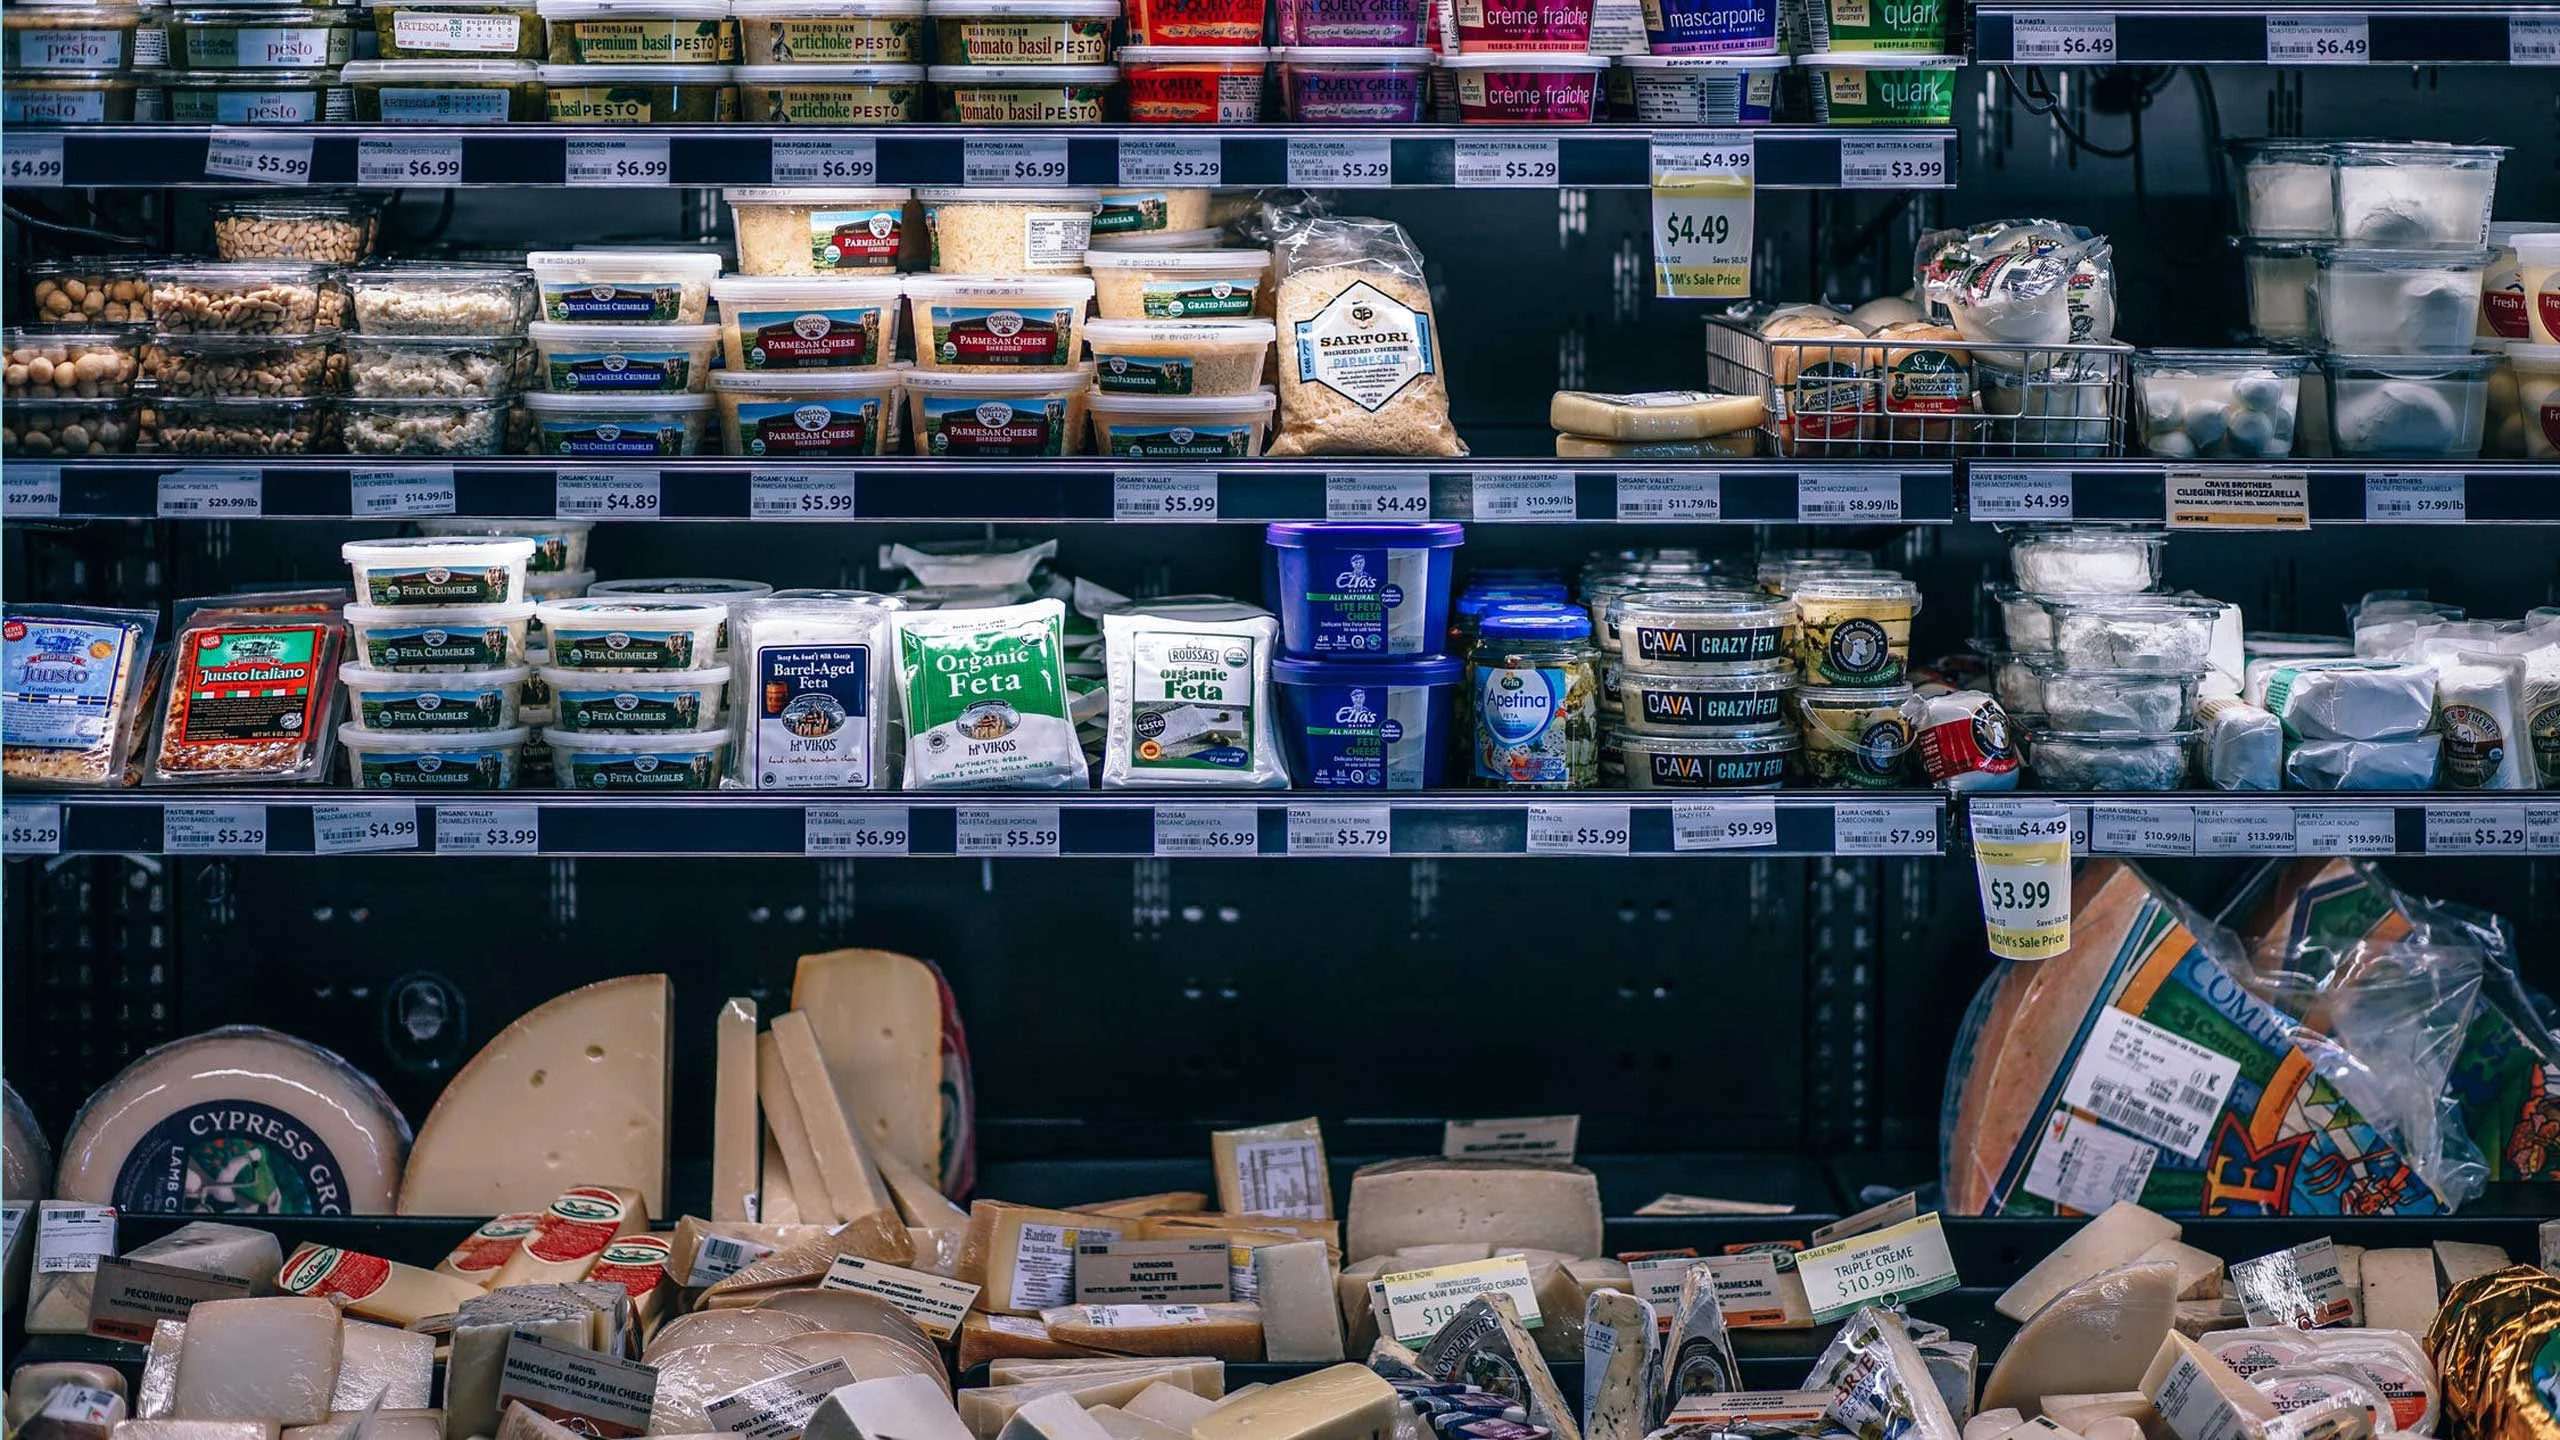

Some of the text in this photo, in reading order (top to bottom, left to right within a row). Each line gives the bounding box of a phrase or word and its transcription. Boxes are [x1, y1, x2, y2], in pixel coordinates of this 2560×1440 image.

[1487, 3, 1588, 25] crème fraîche
[1670, 8, 1766, 30] mascarpone
[1883, 3, 1939, 26] quark
[397, 22, 448, 32] ARTISOLA
[792, 33, 900, 50] artichoke PESTO
[968, 37, 1101, 54] tomato basil PESTO
[2063, 37, 2113, 53] $6.49
[2317, 38, 2366, 54] $6.49
[1367, 76, 1408, 91] GREEK
[1489, 84, 1590, 105] crème fraîche
[1881, 83, 1940, 105] quark
[247, 103, 297, 122] pesto
[790, 102, 899, 118] artichoke PESTO
[961, 103, 1097, 120] tomato basil PESTO
[257, 154, 308, 176] $5.99
[1703, 152, 1750, 168] $4.99
[11, 161, 61, 176] $4.99
[409, 161, 459, 176] $6.99
[616, 161, 667, 176] $6.99
[823, 161, 873, 176] $6.99
[1015, 162, 1065, 177] $6.99
[1173, 162, 1219, 177] $5.29
[1342, 163, 1388, 178] $5.29
[1505, 163, 1556, 178] $5.29
[1891, 162, 1942, 177] $3.99
[1668, 212, 1729, 246] $4.49
[569, 302, 649, 312] BLUE CHEESE CRUMBLES
[769, 339, 855, 349] PARMESAN CHEESE
[960, 336, 1047, 346] PARMESAN CHEESE
[1320, 332, 1409, 347] SARTORI
[1323, 345, 1409, 357] SHREDDED CHEESE
[1334, 354, 1400, 368] PARMESAN
[769, 430, 855, 440] PARMESAN CHEESE
[951, 427, 1038, 437] PARMESAN CHEESE
[1147, 446, 1223, 454] GRATED PARMESAN
[2205, 481, 2272, 490] CRAVE BROTHERS
[9, 493, 58, 504] $27.99/lb
[405, 490, 454, 502] $14.99/lb
[1526, 496, 1574, 506] $10.99/lb
[2177, 489, 2300, 499] CILIEGINI FRESH MOZZARELLA
[208, 497, 258, 508] $29.99/lb
[607, 494, 657, 510] $4.89
[802, 495, 852, 511] $5.99
[1165, 496, 1215, 512] $5.99
[1377, 496, 1427, 513] $4.49
[1668, 499, 1718, 510] $11.79/lb
[1849, 499, 1899, 513] $8.99/lb
[2024, 494, 2070, 510] $4.99
[2417, 500, 2464, 512] $7.99/lb
[1336, 572, 1376, 589] Ezra's
[1642, 630, 1776, 654] CAVA CRAZY FETA
[584, 650, 658, 660] FETA CRUMBLES
[937, 648, 1029, 673] Organic
[1172, 650, 1215, 662] ROUSSAS
[200, 666, 305, 684] Juusto Italiano
[774, 662, 854, 676] Barrel-Aged
[1160, 666, 1228, 687] organic
[1820, 665, 1861, 684] MARINATED
[800, 677, 829, 689] Feta
[950, 671, 1022, 697] Feta
[1164, 680, 1223, 701] Feta
[1487, 689, 1548, 710] Apetina
[1648, 693, 1778, 717] CAVA CRAZY FETA
[394, 711, 468, 721] FETA CRUMBLES
[592, 711, 666, 721] FETA CRUMBLES
[1336, 707, 1376, 724] Ezra's
[1137, 718, 1165, 731] taste
[1357, 738, 1381, 746] FETA
[1346, 746, 1381, 755] CHEESE
[1655, 756, 1763, 779] CAVA CRAZY
[394, 773, 468, 783] FETA CRUMBLES
[610, 773, 683, 783] FETA CRUMBLES
[370, 822, 416, 838] $4.99
[1727, 821, 1773, 837] $9.99
[2020, 820, 2067, 836] $4.49
[12, 829, 58, 844] $5.29
[218, 829, 264, 845] $5.29
[487, 830, 537, 846] $3.99
[856, 831, 906, 846] $6.99
[1007, 831, 1057, 846] $5.59
[1209, 832, 1255, 847] $6.99
[1337, 830, 1387, 846] $5.79
[1577, 829, 1627, 845] $5.99
[1890, 829, 1936, 844] $7.99
[2144, 831, 2192, 842] $10.99/lb
[2247, 831, 2295, 842] $13.99/lb
[2347, 833, 2395, 845] $19.99/lb
[2474, 829, 2523, 845] $5.29
[1991, 878, 2050, 910] $3.99
[2019, 935, 2040, 948] Sale
[2042, 933, 2065, 945] Price
[189, 1110, 313, 1160] CYPRESS
[166, 1146, 185, 1192] LAMB
[1798, 1243, 1847, 1263] ON SALE NOW!
[1834, 1247, 1914, 1277] TRIPLE CREME
[1129, 1272, 1178, 1282] RACLETTE
[1394, 1273, 1413, 1283] SALE
[1714, 1279, 1763, 1290] PARMESAN
[1837, 1264, 1920, 1298] $10.99/lb.
[124, 1287, 173, 1304] PECORINO
[885, 1288, 925, 1304] REGGIANO
[1392, 1277, 1529, 1306] ORGANIC RAW MANCHEGO CURADO
[508, 1358, 562, 1379] MANCHEGO
[564, 1374, 586, 1386] 6MO
[588, 1378, 616, 1395] SPAIN
[618, 1386, 655, 1404] CHEESE
[1832, 1351, 1876, 1407] BRIE
